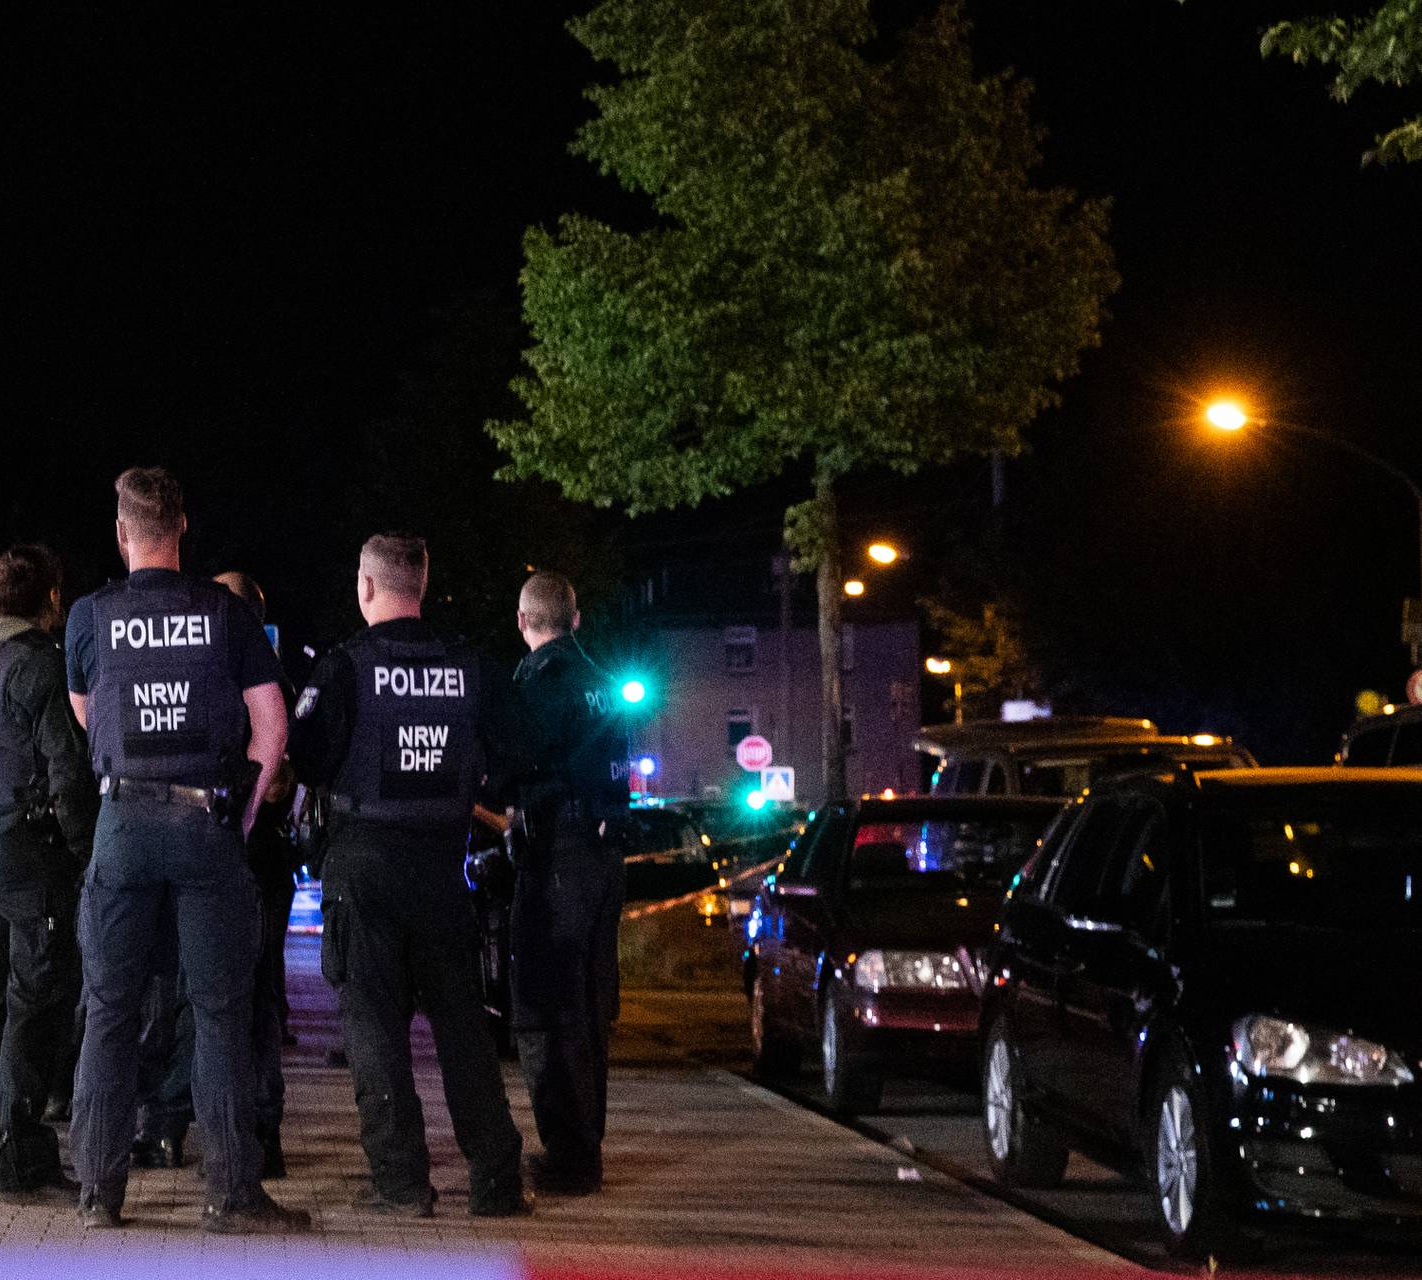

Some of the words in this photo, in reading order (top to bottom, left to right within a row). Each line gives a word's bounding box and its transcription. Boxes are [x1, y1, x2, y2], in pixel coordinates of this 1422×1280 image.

[111, 615, 211, 650] POLIZEI
[134, 681, 190, 706] NRW
[375, 666, 465, 697] POLIZEI
[140, 707, 187, 732] DHF
[398, 725, 449, 748] NRW
[401, 748, 443, 772] DHF
